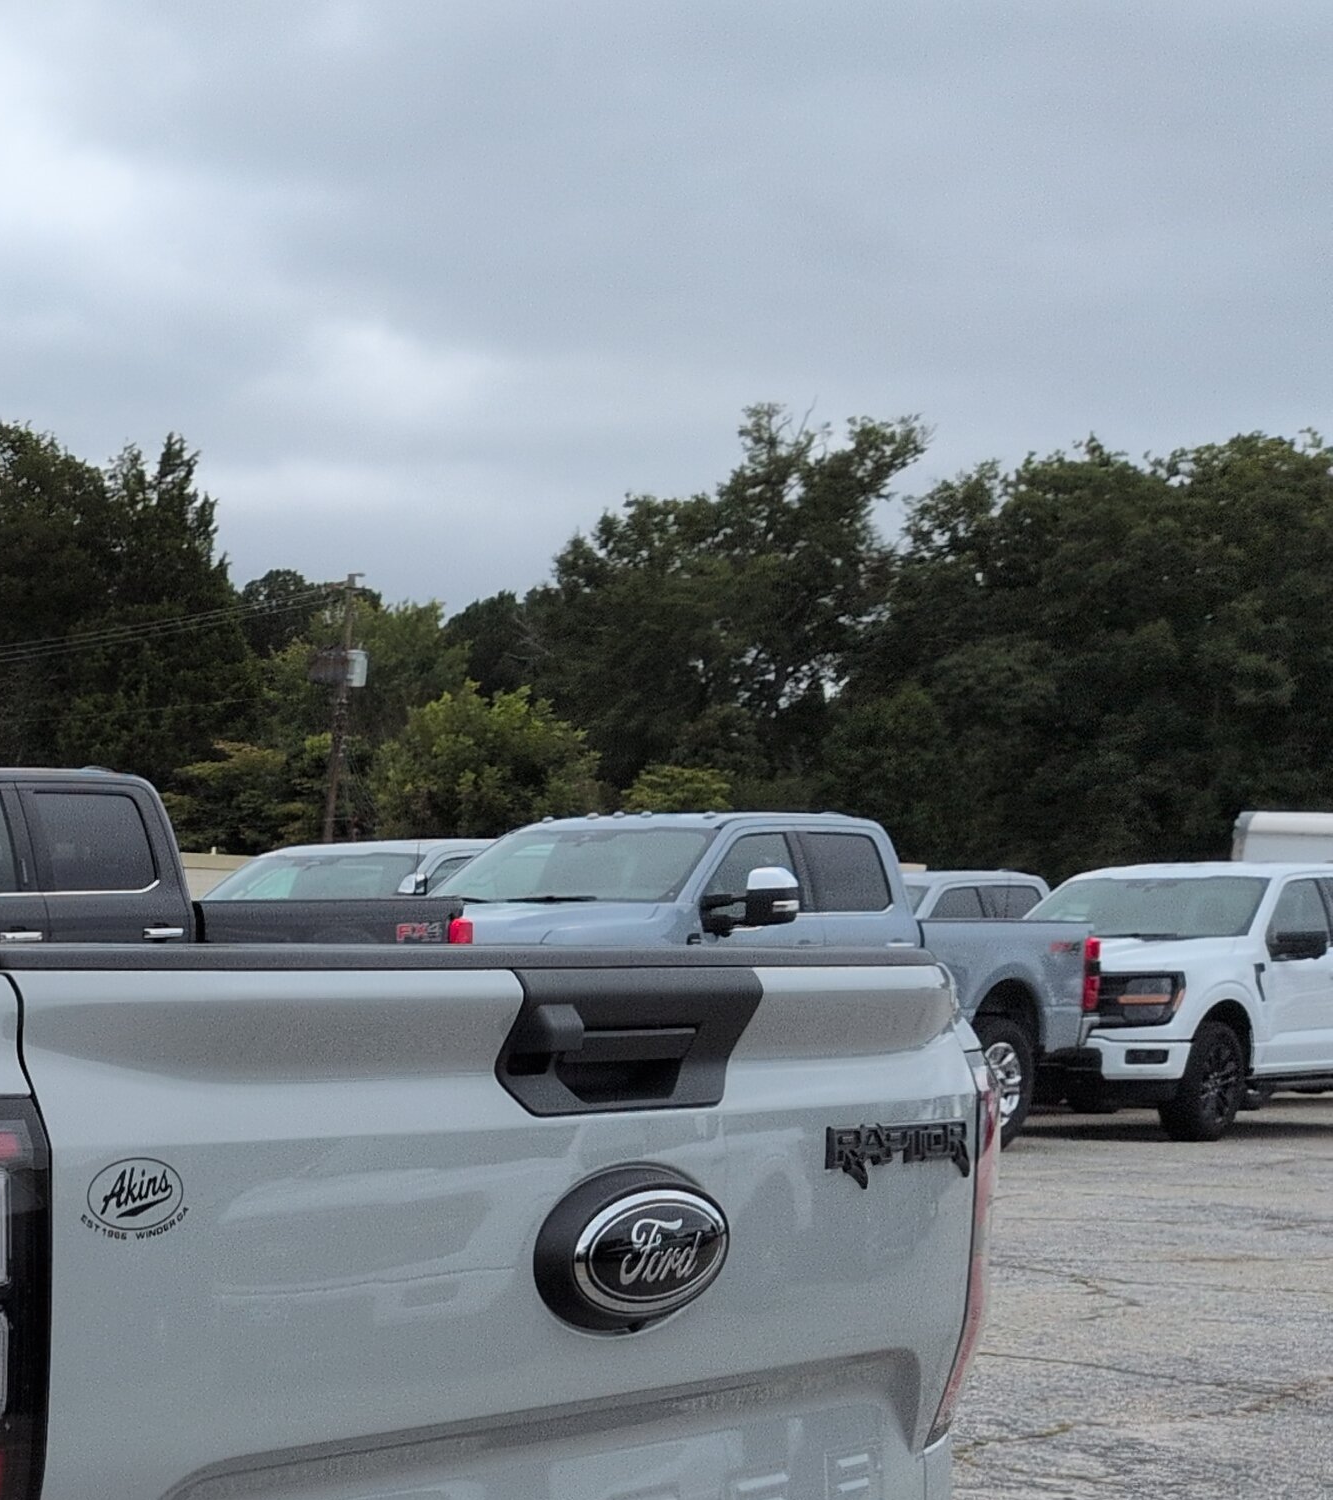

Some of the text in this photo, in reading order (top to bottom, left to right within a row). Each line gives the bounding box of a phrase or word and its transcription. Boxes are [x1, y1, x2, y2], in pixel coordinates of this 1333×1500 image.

[824, 1121, 971, 1189] RAPTOR
[80, 1213, 100, 1232] EST
[100, 1166, 173, 1219] Akins
[619, 1218, 703, 1286] Ford
